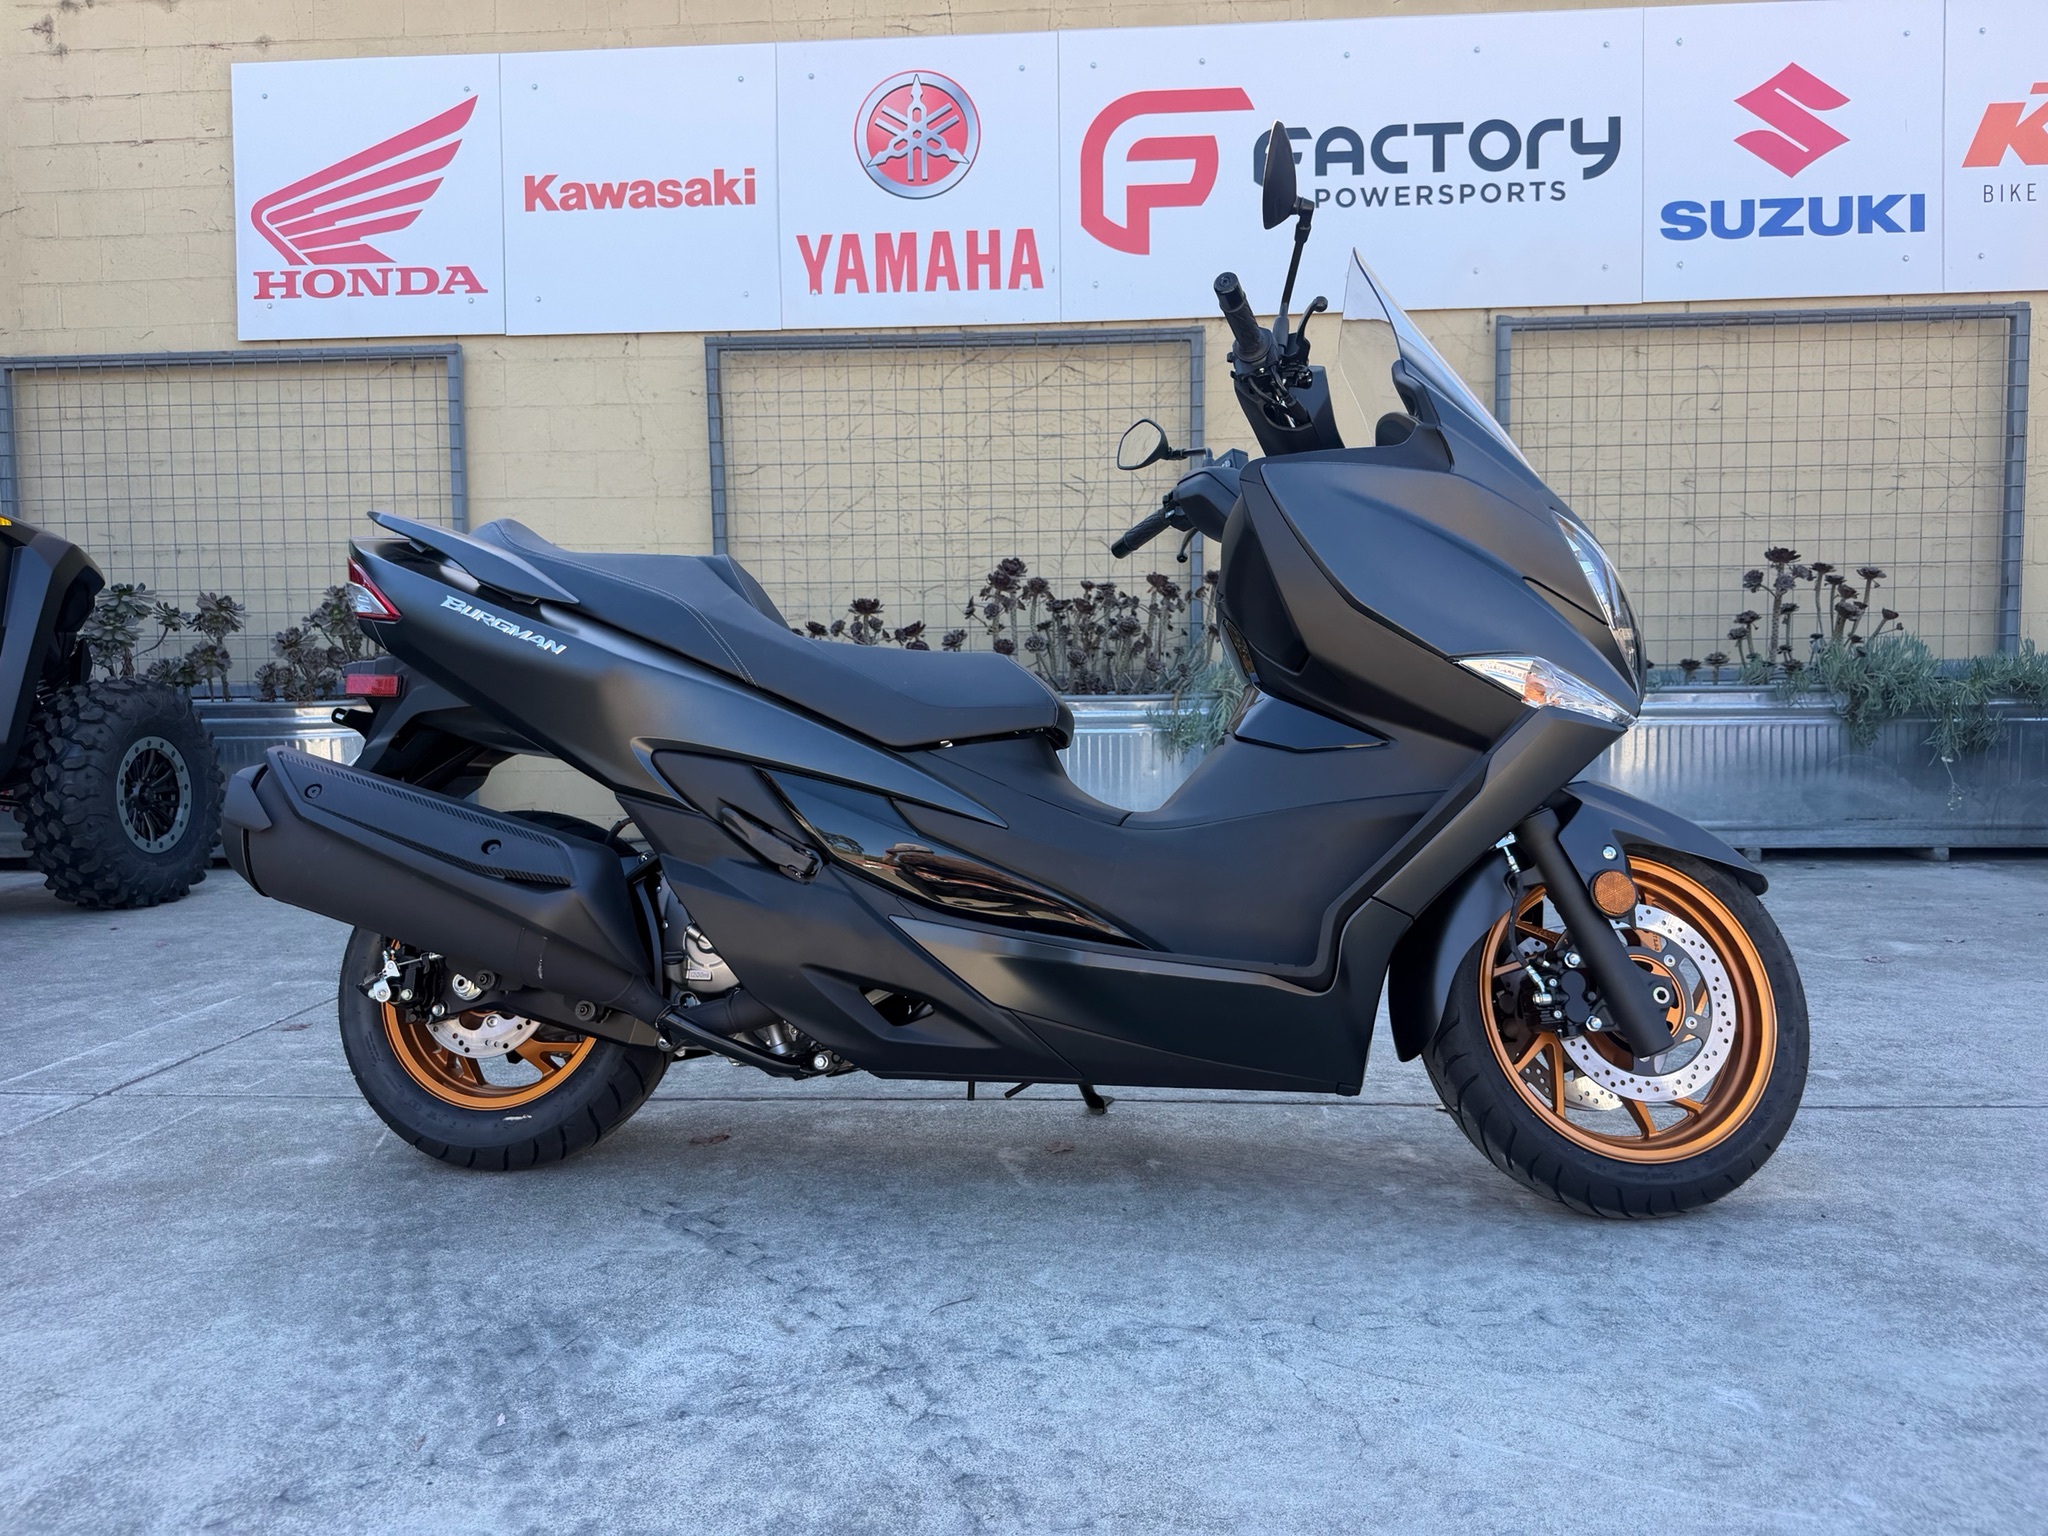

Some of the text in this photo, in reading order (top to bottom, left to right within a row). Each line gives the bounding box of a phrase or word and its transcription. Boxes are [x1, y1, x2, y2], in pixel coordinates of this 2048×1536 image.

[1962, 82, 2048, 168] K
[524, 168, 756, 212] Kawasaki
[1314, 180, 1566, 209] POWERSPORTS
[1984, 183, 2037, 203] BIKE
[1660, 193, 1926, 241] SUZUKI
[253, 265, 489, 300] HONDA
[796, 228, 1044, 295] YAMAHA
[440, 595, 567, 655] BURGMAN
